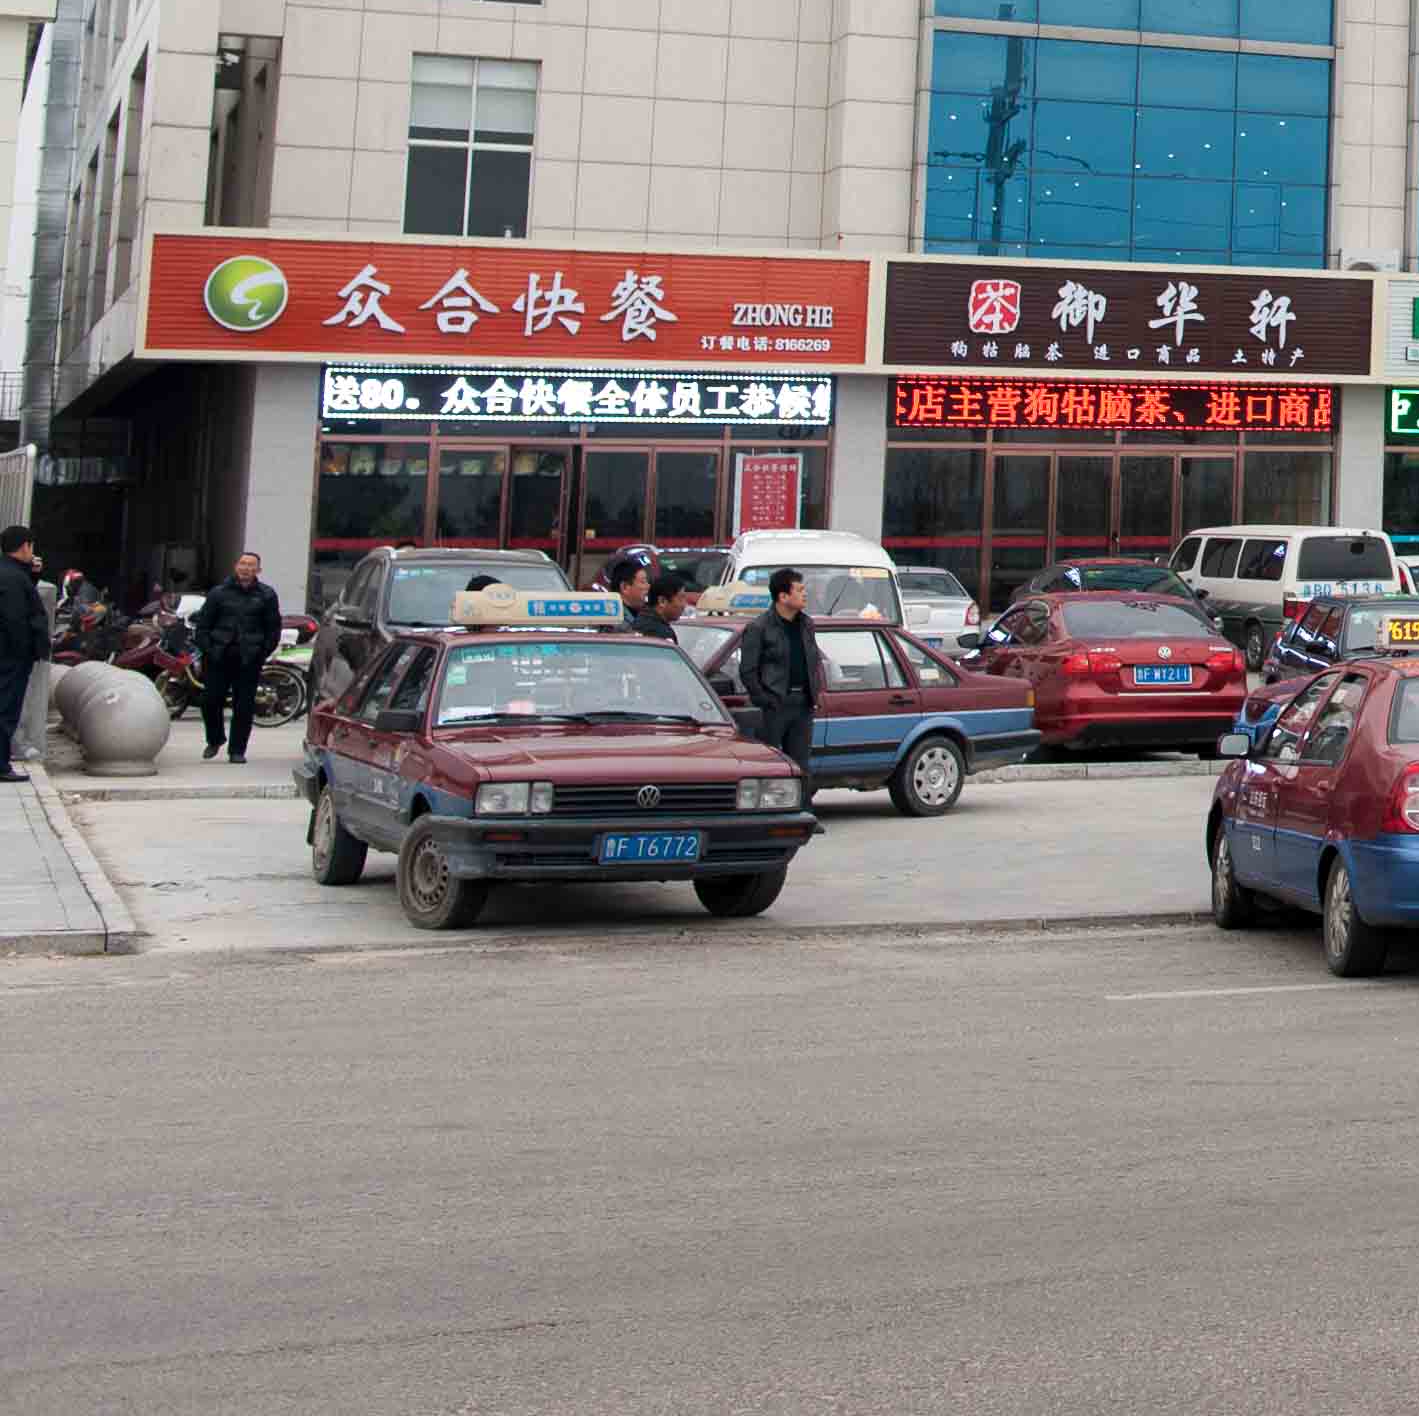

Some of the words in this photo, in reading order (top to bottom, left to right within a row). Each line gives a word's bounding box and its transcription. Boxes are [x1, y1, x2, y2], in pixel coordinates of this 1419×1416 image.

[321, 263, 679, 342] 众合快餐
[731, 303, 803, 328] ZHONG
[805, 306, 833, 329] HE
[1052, 280, 1296, 350] 御华轩
[951, 340, 1063, 362] 狗牯脑茶
[1094, 344, 1201, 365] 进口商品
[1231, 347, 1305, 368] 土特产
[896, 384, 1331, 427] 店主营狗牯脑茶、进口商
